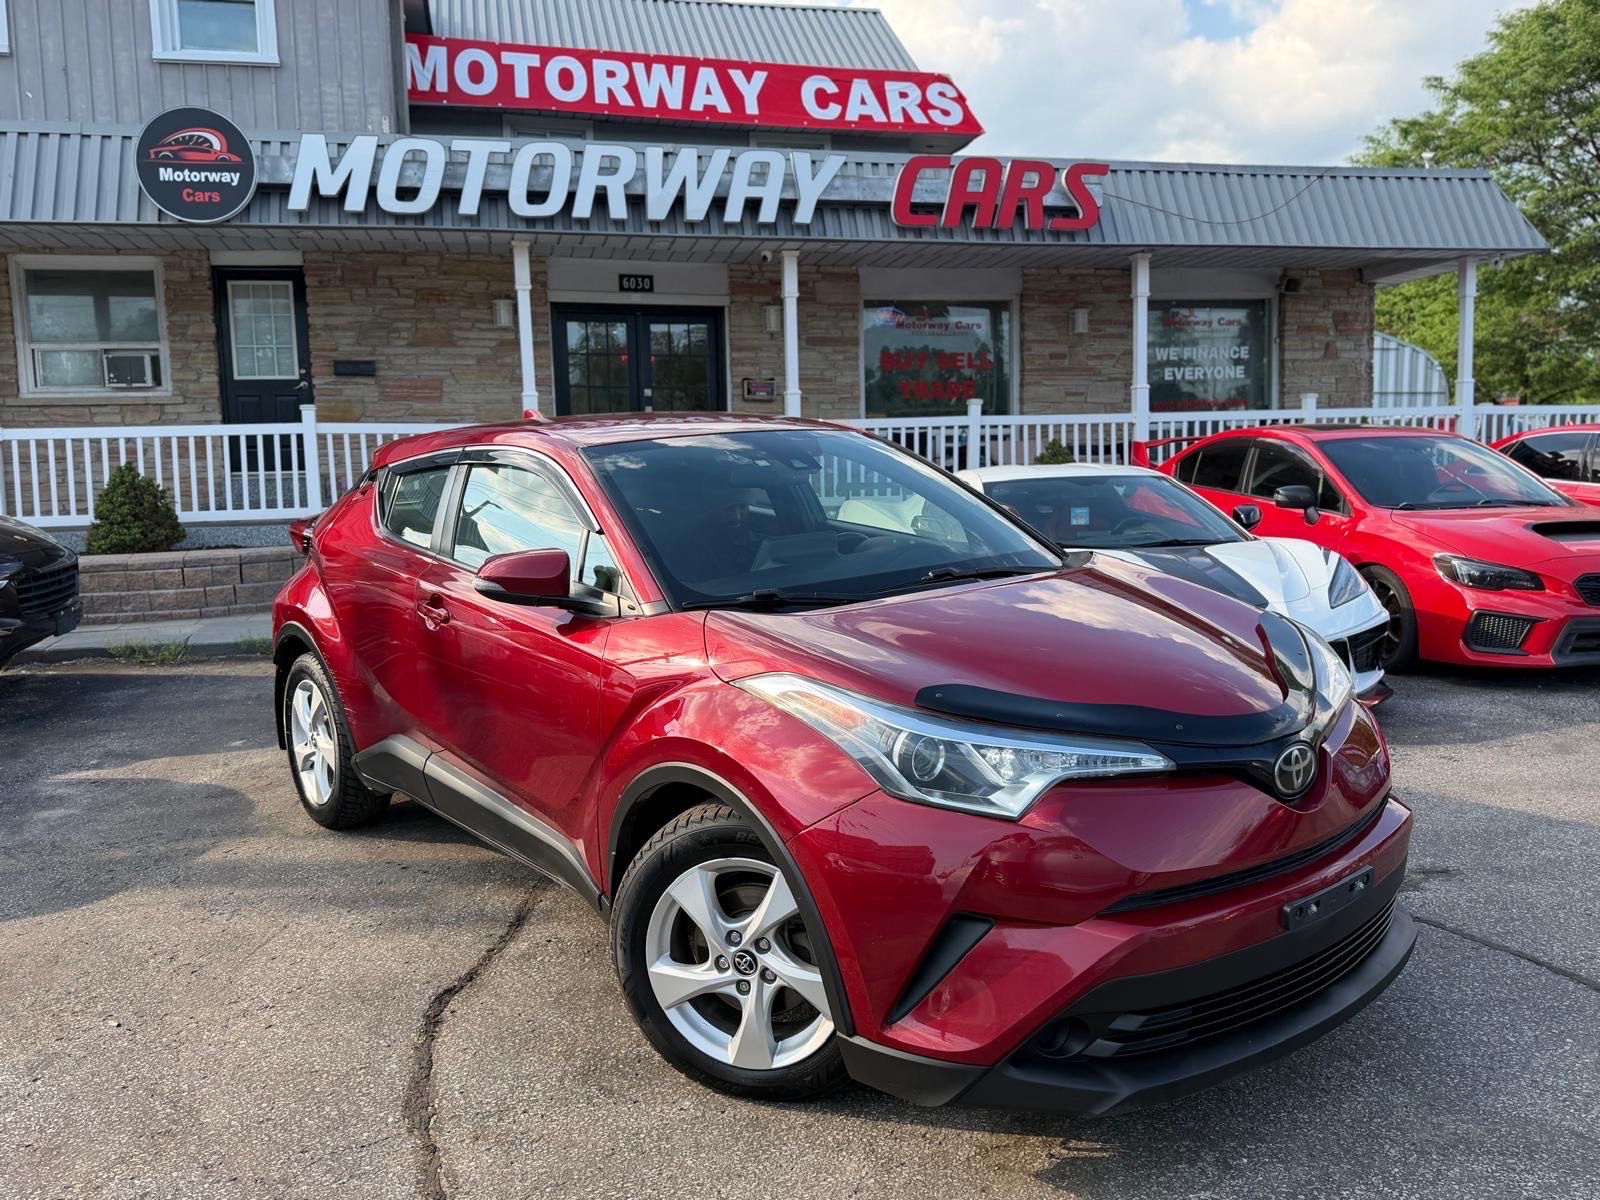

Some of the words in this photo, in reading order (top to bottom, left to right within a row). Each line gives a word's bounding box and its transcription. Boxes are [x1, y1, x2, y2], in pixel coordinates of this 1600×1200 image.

[405, 42, 768, 116] MOTORWAY
[801, 75, 963, 126] CARS
[158, 167, 241, 186] Motorway
[287, 133, 848, 225] MOTORWAY
[891, 155, 1110, 231] CARS
[182, 188, 221, 203] Cars
[622, 276, 650, 289] 6030
[895, 320, 950, 331] Motorway
[954, 320, 982, 330] Cars
[880, 352, 929, 370] BUY
[936, 352, 994, 370] SELL
[1155, 347, 1179, 361] WE
[1183, 346, 1250, 360] FINANCE
[1164, 366, 1245, 381] EVERYONE
[898, 379, 977, 400] TRADE
